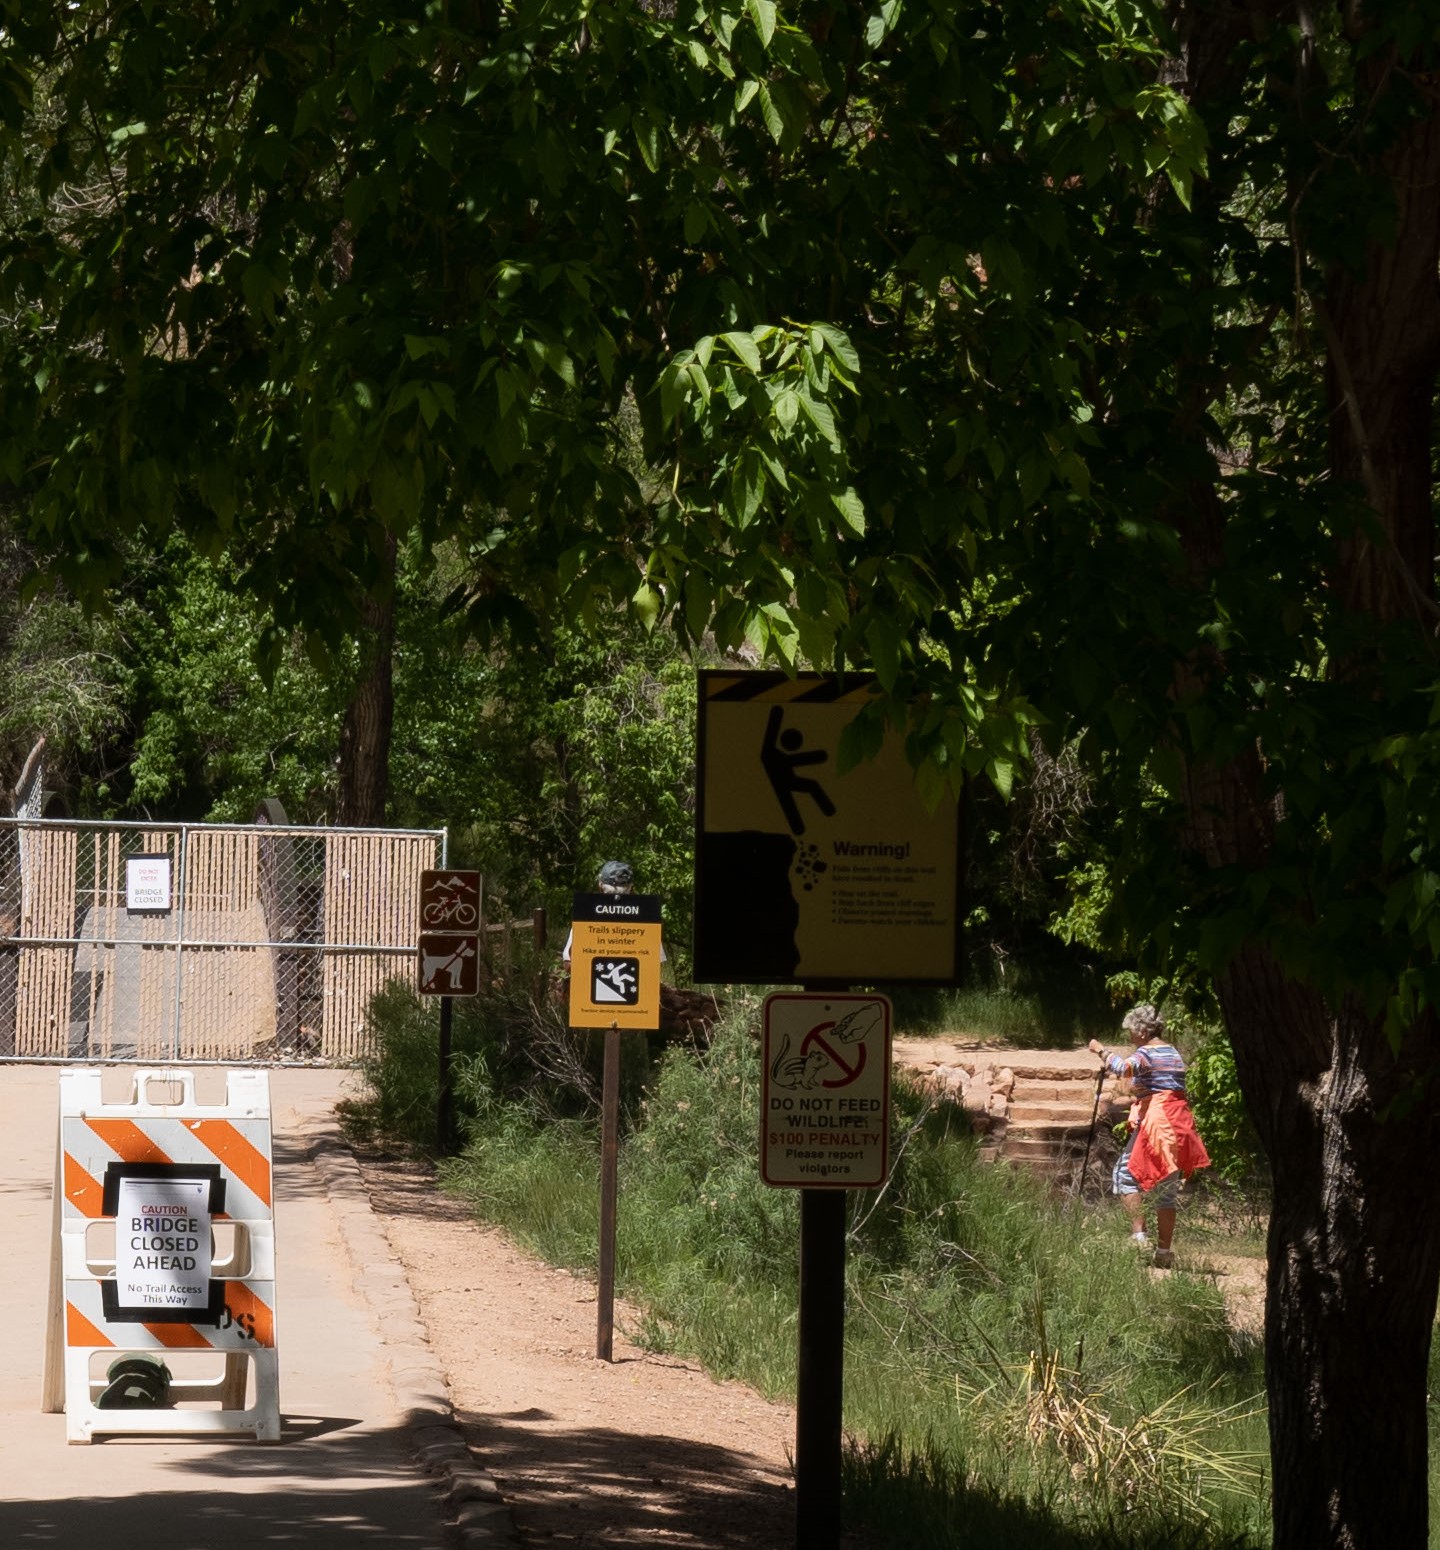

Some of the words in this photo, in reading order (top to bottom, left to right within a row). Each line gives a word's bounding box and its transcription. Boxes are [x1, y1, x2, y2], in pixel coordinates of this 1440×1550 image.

[833, 841, 910, 859] Warning!
[595, 905, 639, 915] CAUTION
[612, 926, 645, 936] slippery
[770, 1098, 794, 1110] DO
[800, 1098, 833, 1111] NOT
[839, 1099, 880, 1111] FEED
[769, 1133, 804, 1145] $100
[809, 1133, 880, 1146] PENALTY
[786, 1149, 824, 1159] Please
[828, 1150, 864, 1161] report
[800, 1163, 850, 1174] violators
[141, 1205, 187, 1215] CAUTION
[132, 1218, 198, 1232] BRIDGE
[131, 1237, 199, 1251] CLOSED
[133, 1256, 196, 1271] AHEAD
[128, 1284, 142, 1292] No
[145, 1285, 166, 1293] Trail
[169, 1285, 202, 1294] Access
[143, 1295, 162, 1303] This
[166, 1295, 188, 1305] Way
